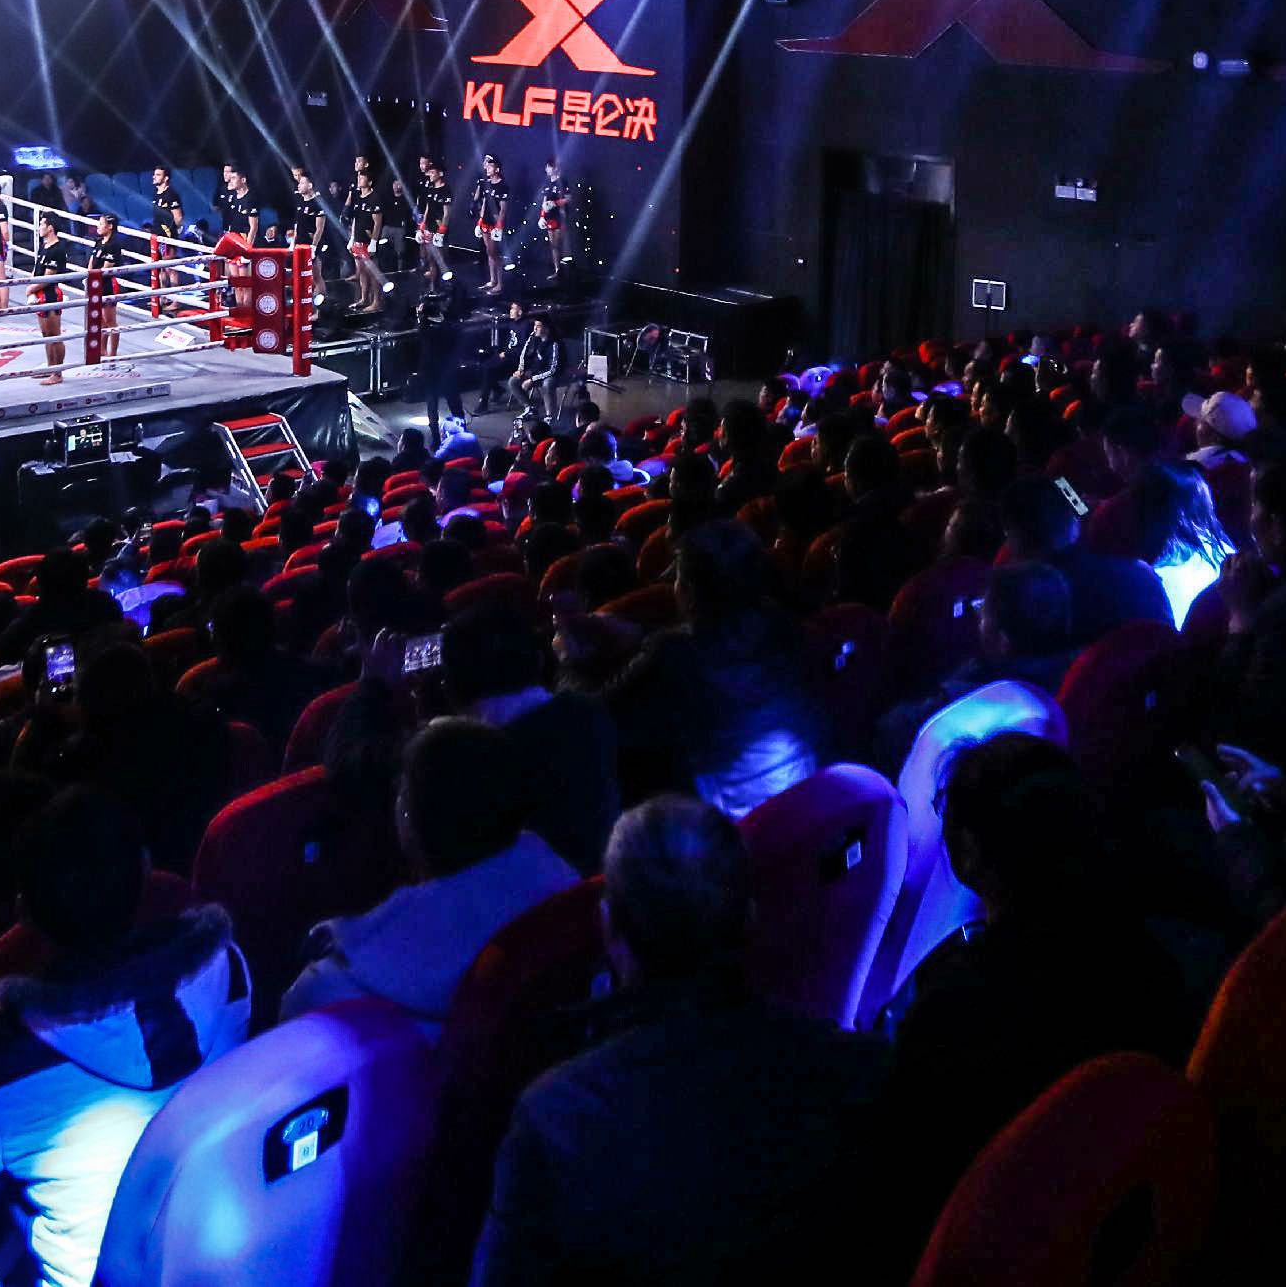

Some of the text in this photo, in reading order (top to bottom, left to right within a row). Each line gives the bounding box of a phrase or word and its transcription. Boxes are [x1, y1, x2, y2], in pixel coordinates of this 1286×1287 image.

[463, 81, 658, 142] KLF 昆仑决
